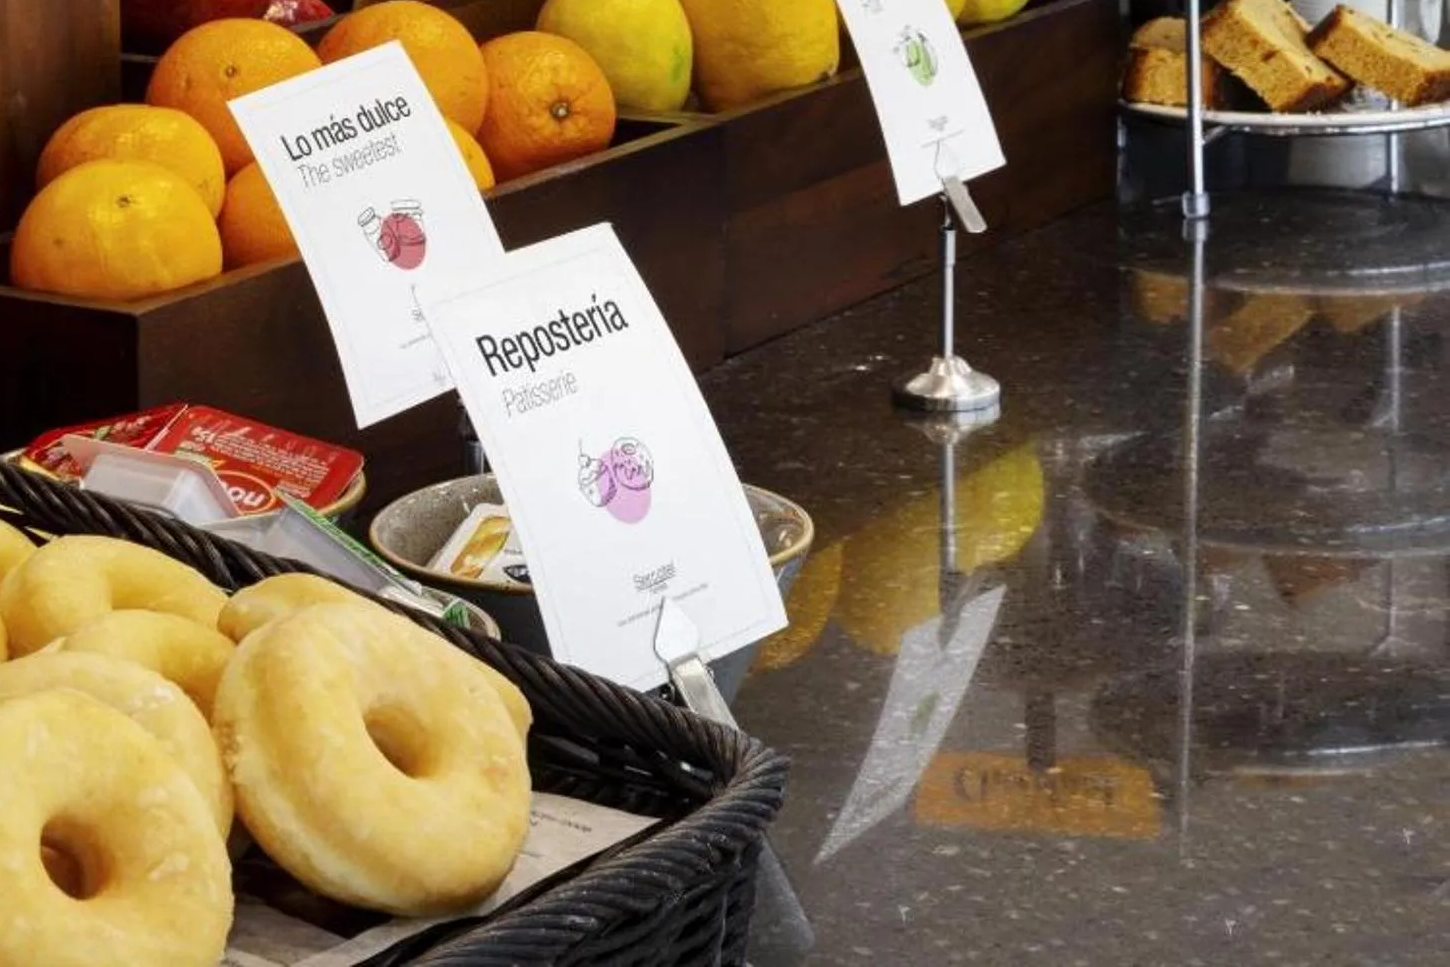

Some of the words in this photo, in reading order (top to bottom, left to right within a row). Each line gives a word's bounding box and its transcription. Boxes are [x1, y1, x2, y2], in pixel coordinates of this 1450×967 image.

[280, 134, 312, 161] Lo
[313, 114, 358, 150] más
[357, 95, 411, 132] dulce
[297, 162, 330, 187] The
[332, 134, 401, 177] sweetest
[475, 293, 629, 377] Repostería
[502, 372, 579, 418] Patisserie
